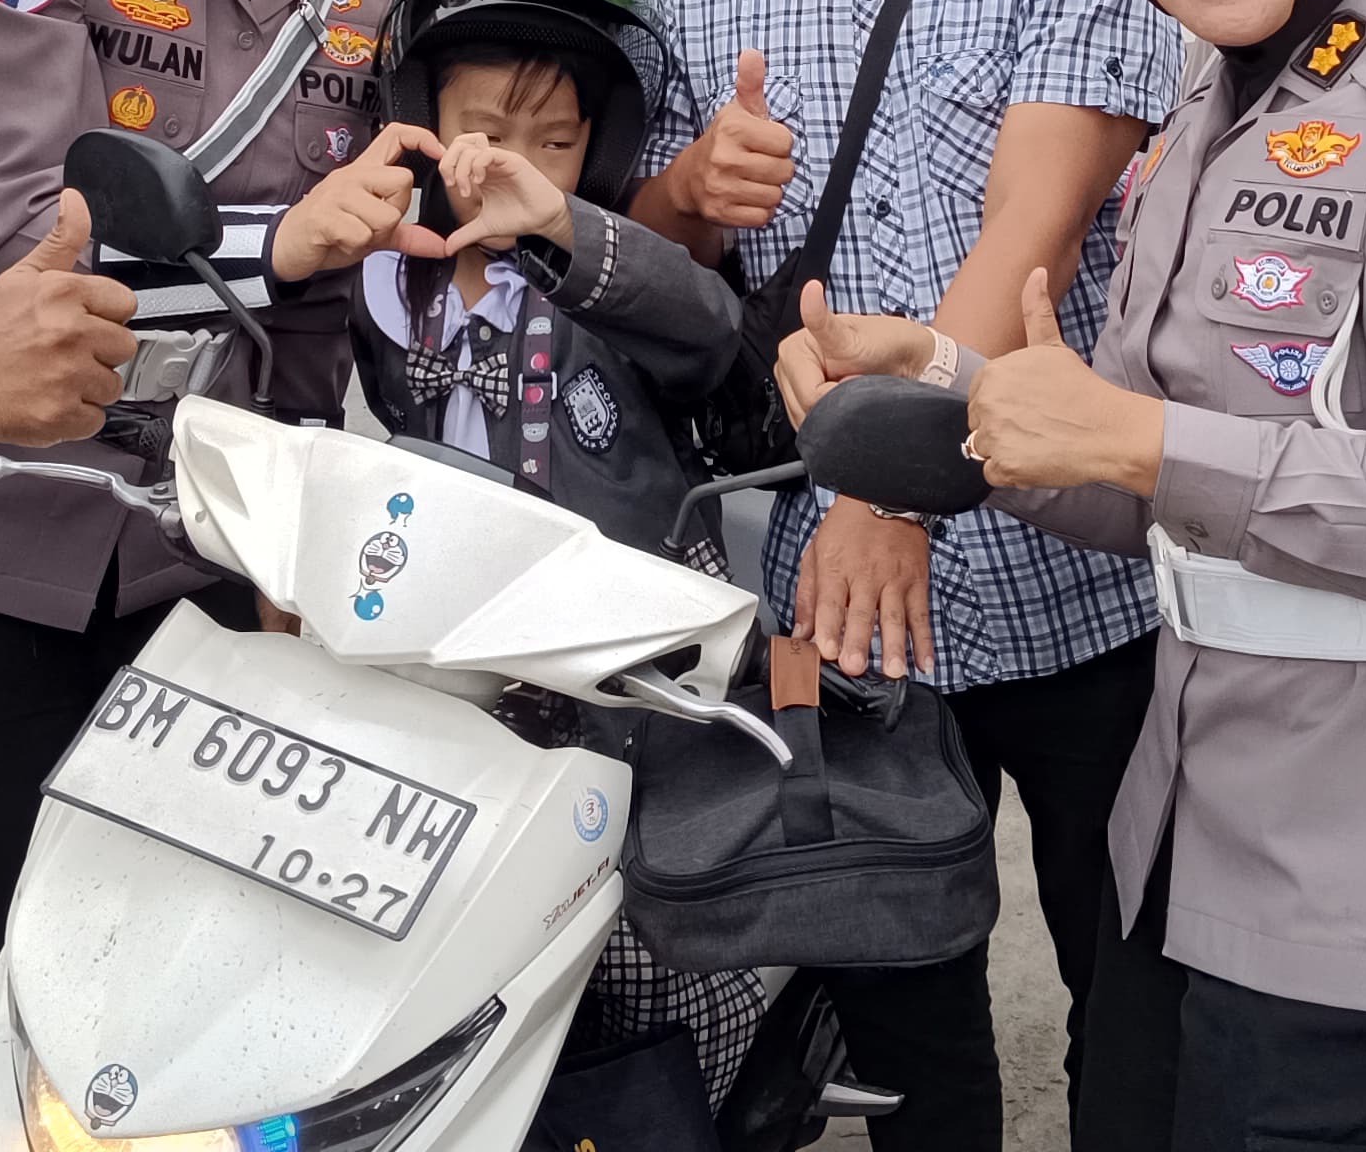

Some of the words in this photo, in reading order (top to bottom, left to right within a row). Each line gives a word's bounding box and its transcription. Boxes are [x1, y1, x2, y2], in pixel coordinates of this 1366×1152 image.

[89, 21, 203, 81] WULAN
[1225, 189, 1353, 240] POLRI
[95, 675, 192, 749] BM
[193, 714, 347, 813] 6093
[365, 782, 463, 863] NW
